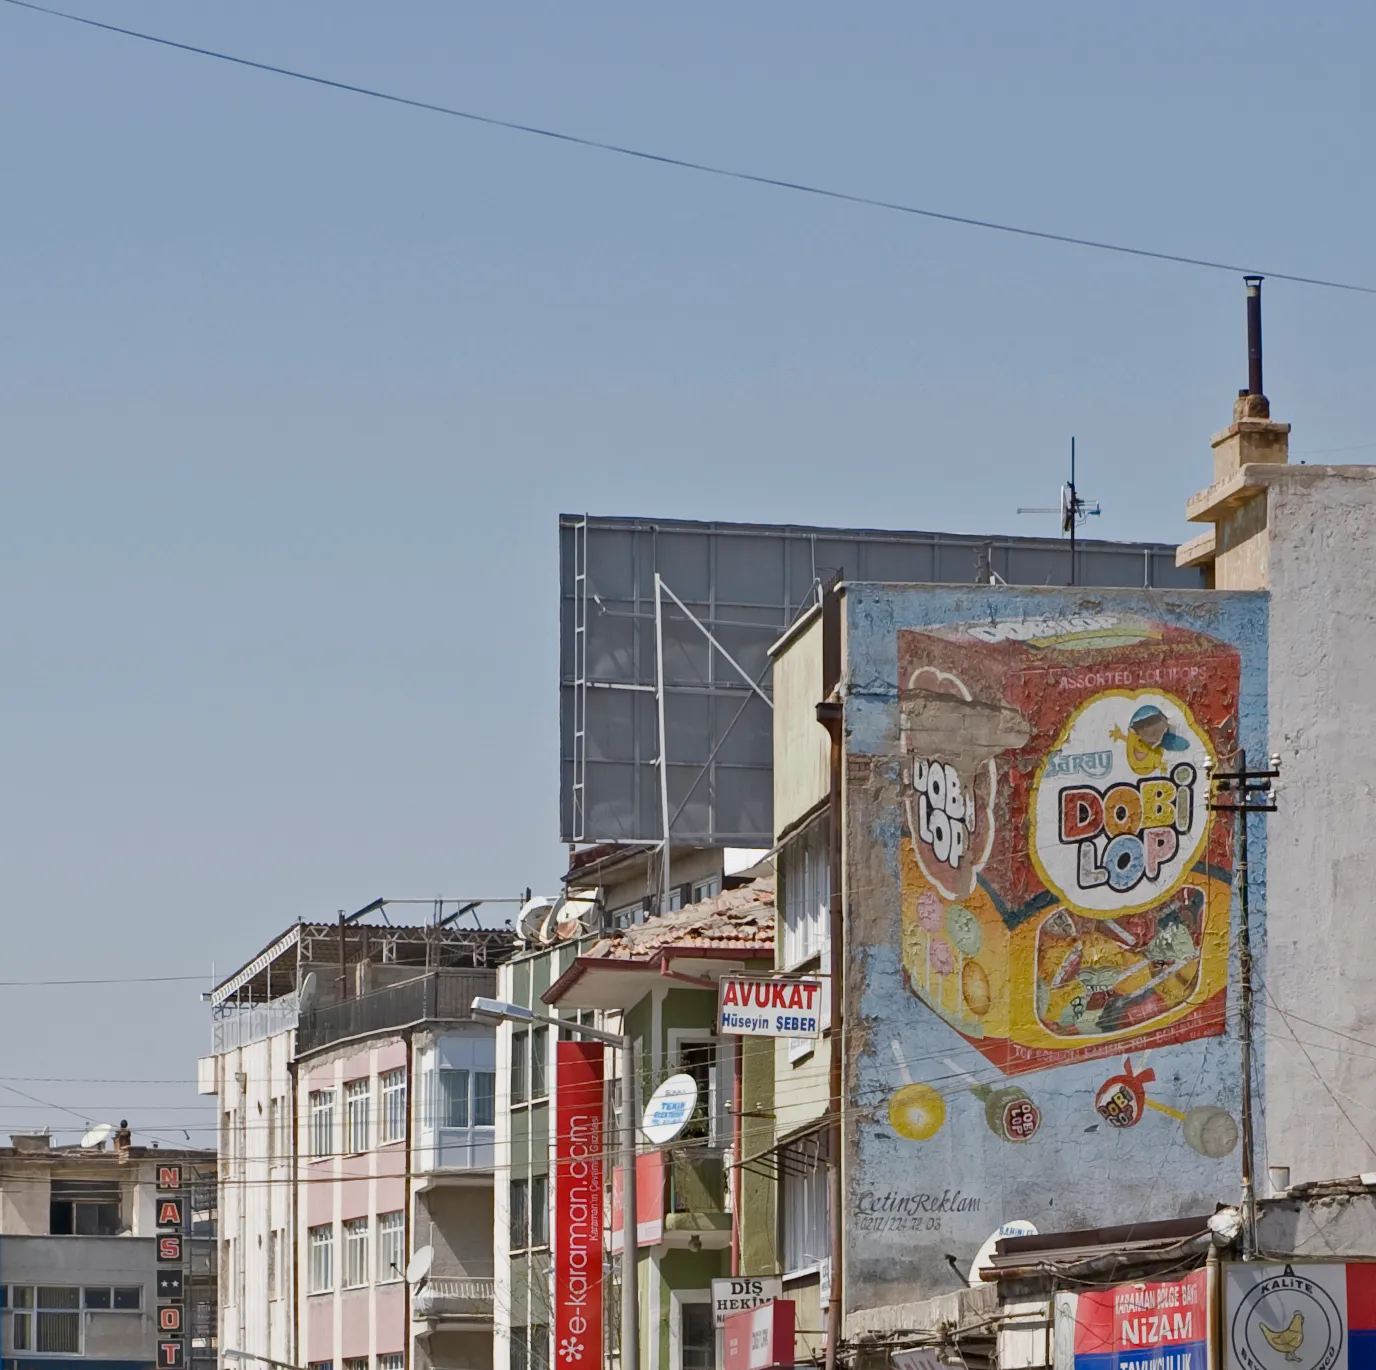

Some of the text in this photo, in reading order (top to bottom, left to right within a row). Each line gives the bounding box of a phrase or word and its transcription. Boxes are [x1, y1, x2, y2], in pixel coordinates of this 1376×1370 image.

[1076, 828, 1179, 894] LOP
[722, 981, 818, 1010] AVUKAT
[722, 1013, 816, 1032] Hüseyin ŞEBER
[564, 1115, 588, 1334] e-karaman.com
